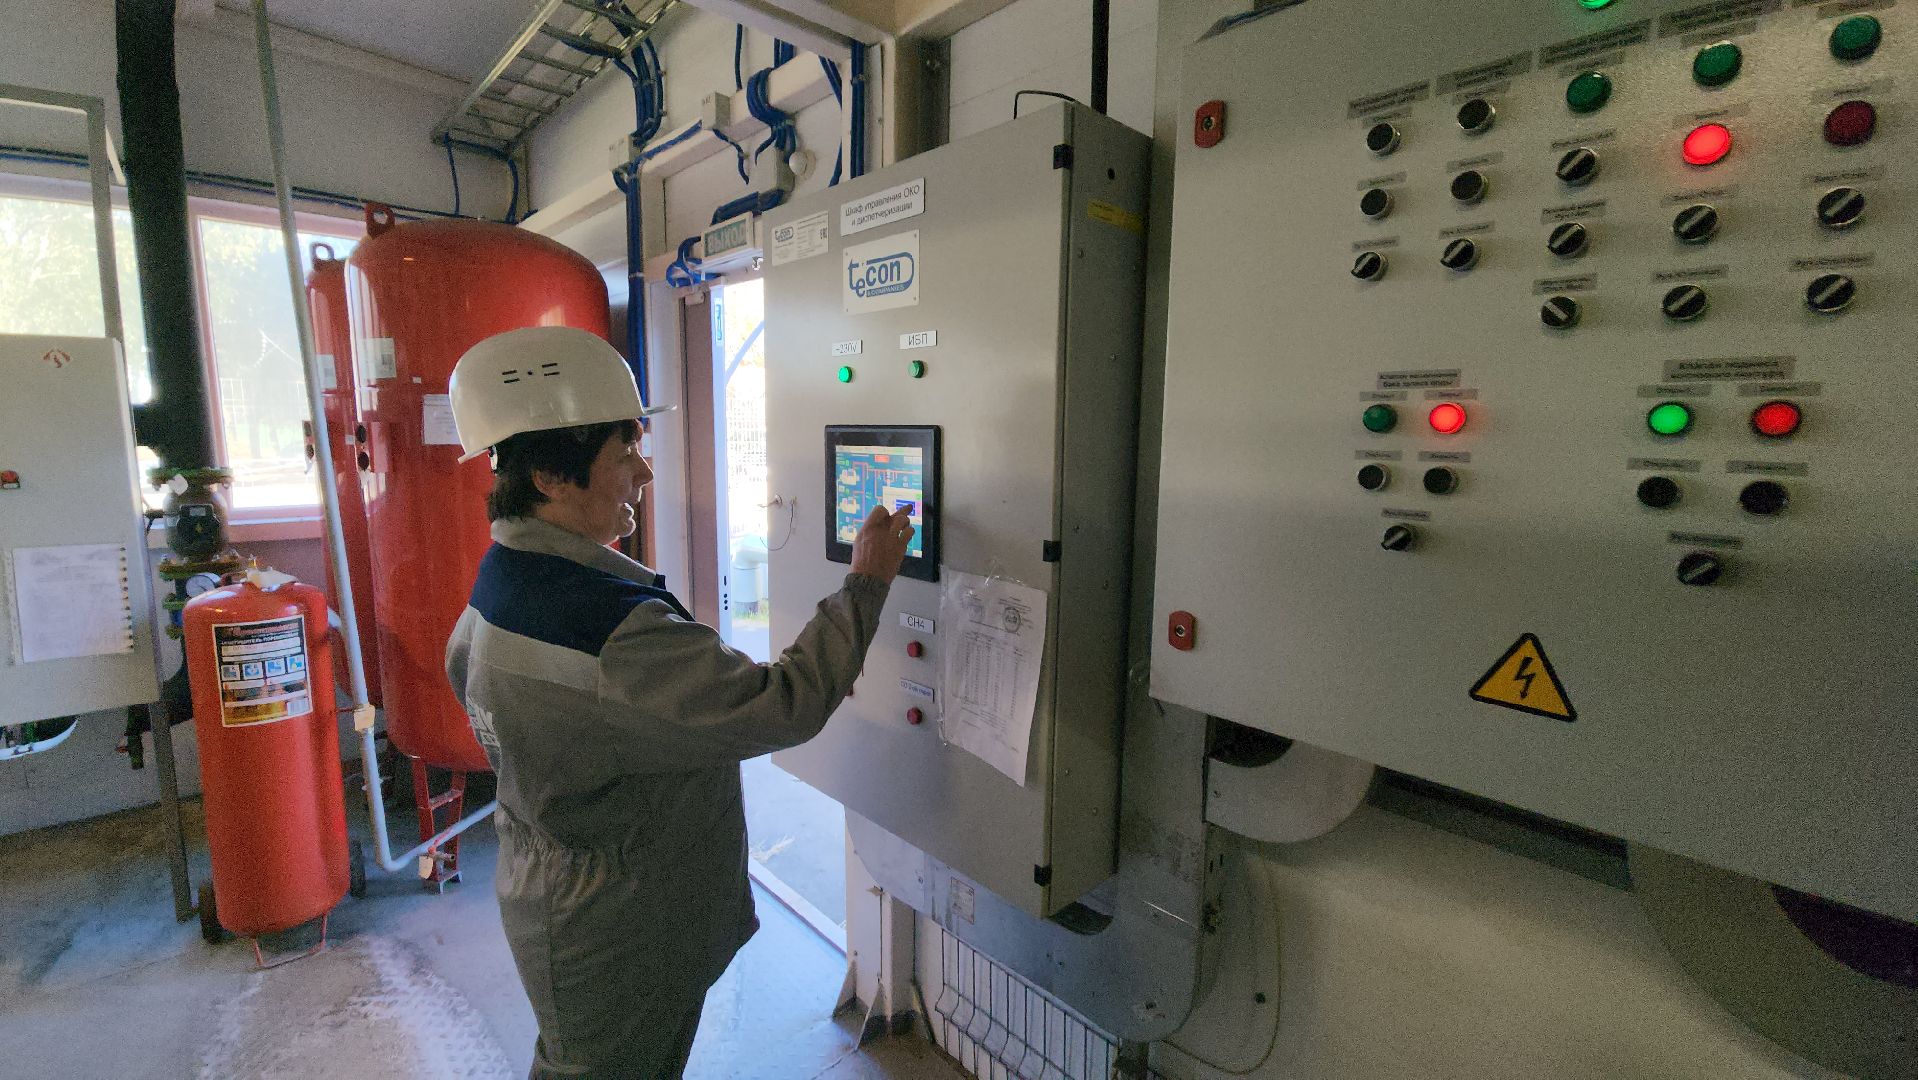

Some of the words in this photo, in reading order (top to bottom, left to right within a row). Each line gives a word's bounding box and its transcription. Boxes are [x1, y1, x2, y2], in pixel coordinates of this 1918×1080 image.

[845, 203, 864, 217] Шкаф
[864, 192, 902, 212] управления
[903, 184, 920, 198] ОКО
[856, 201, 913, 226] диспетчеризации
[908, 333, 928, 346] ИБП
